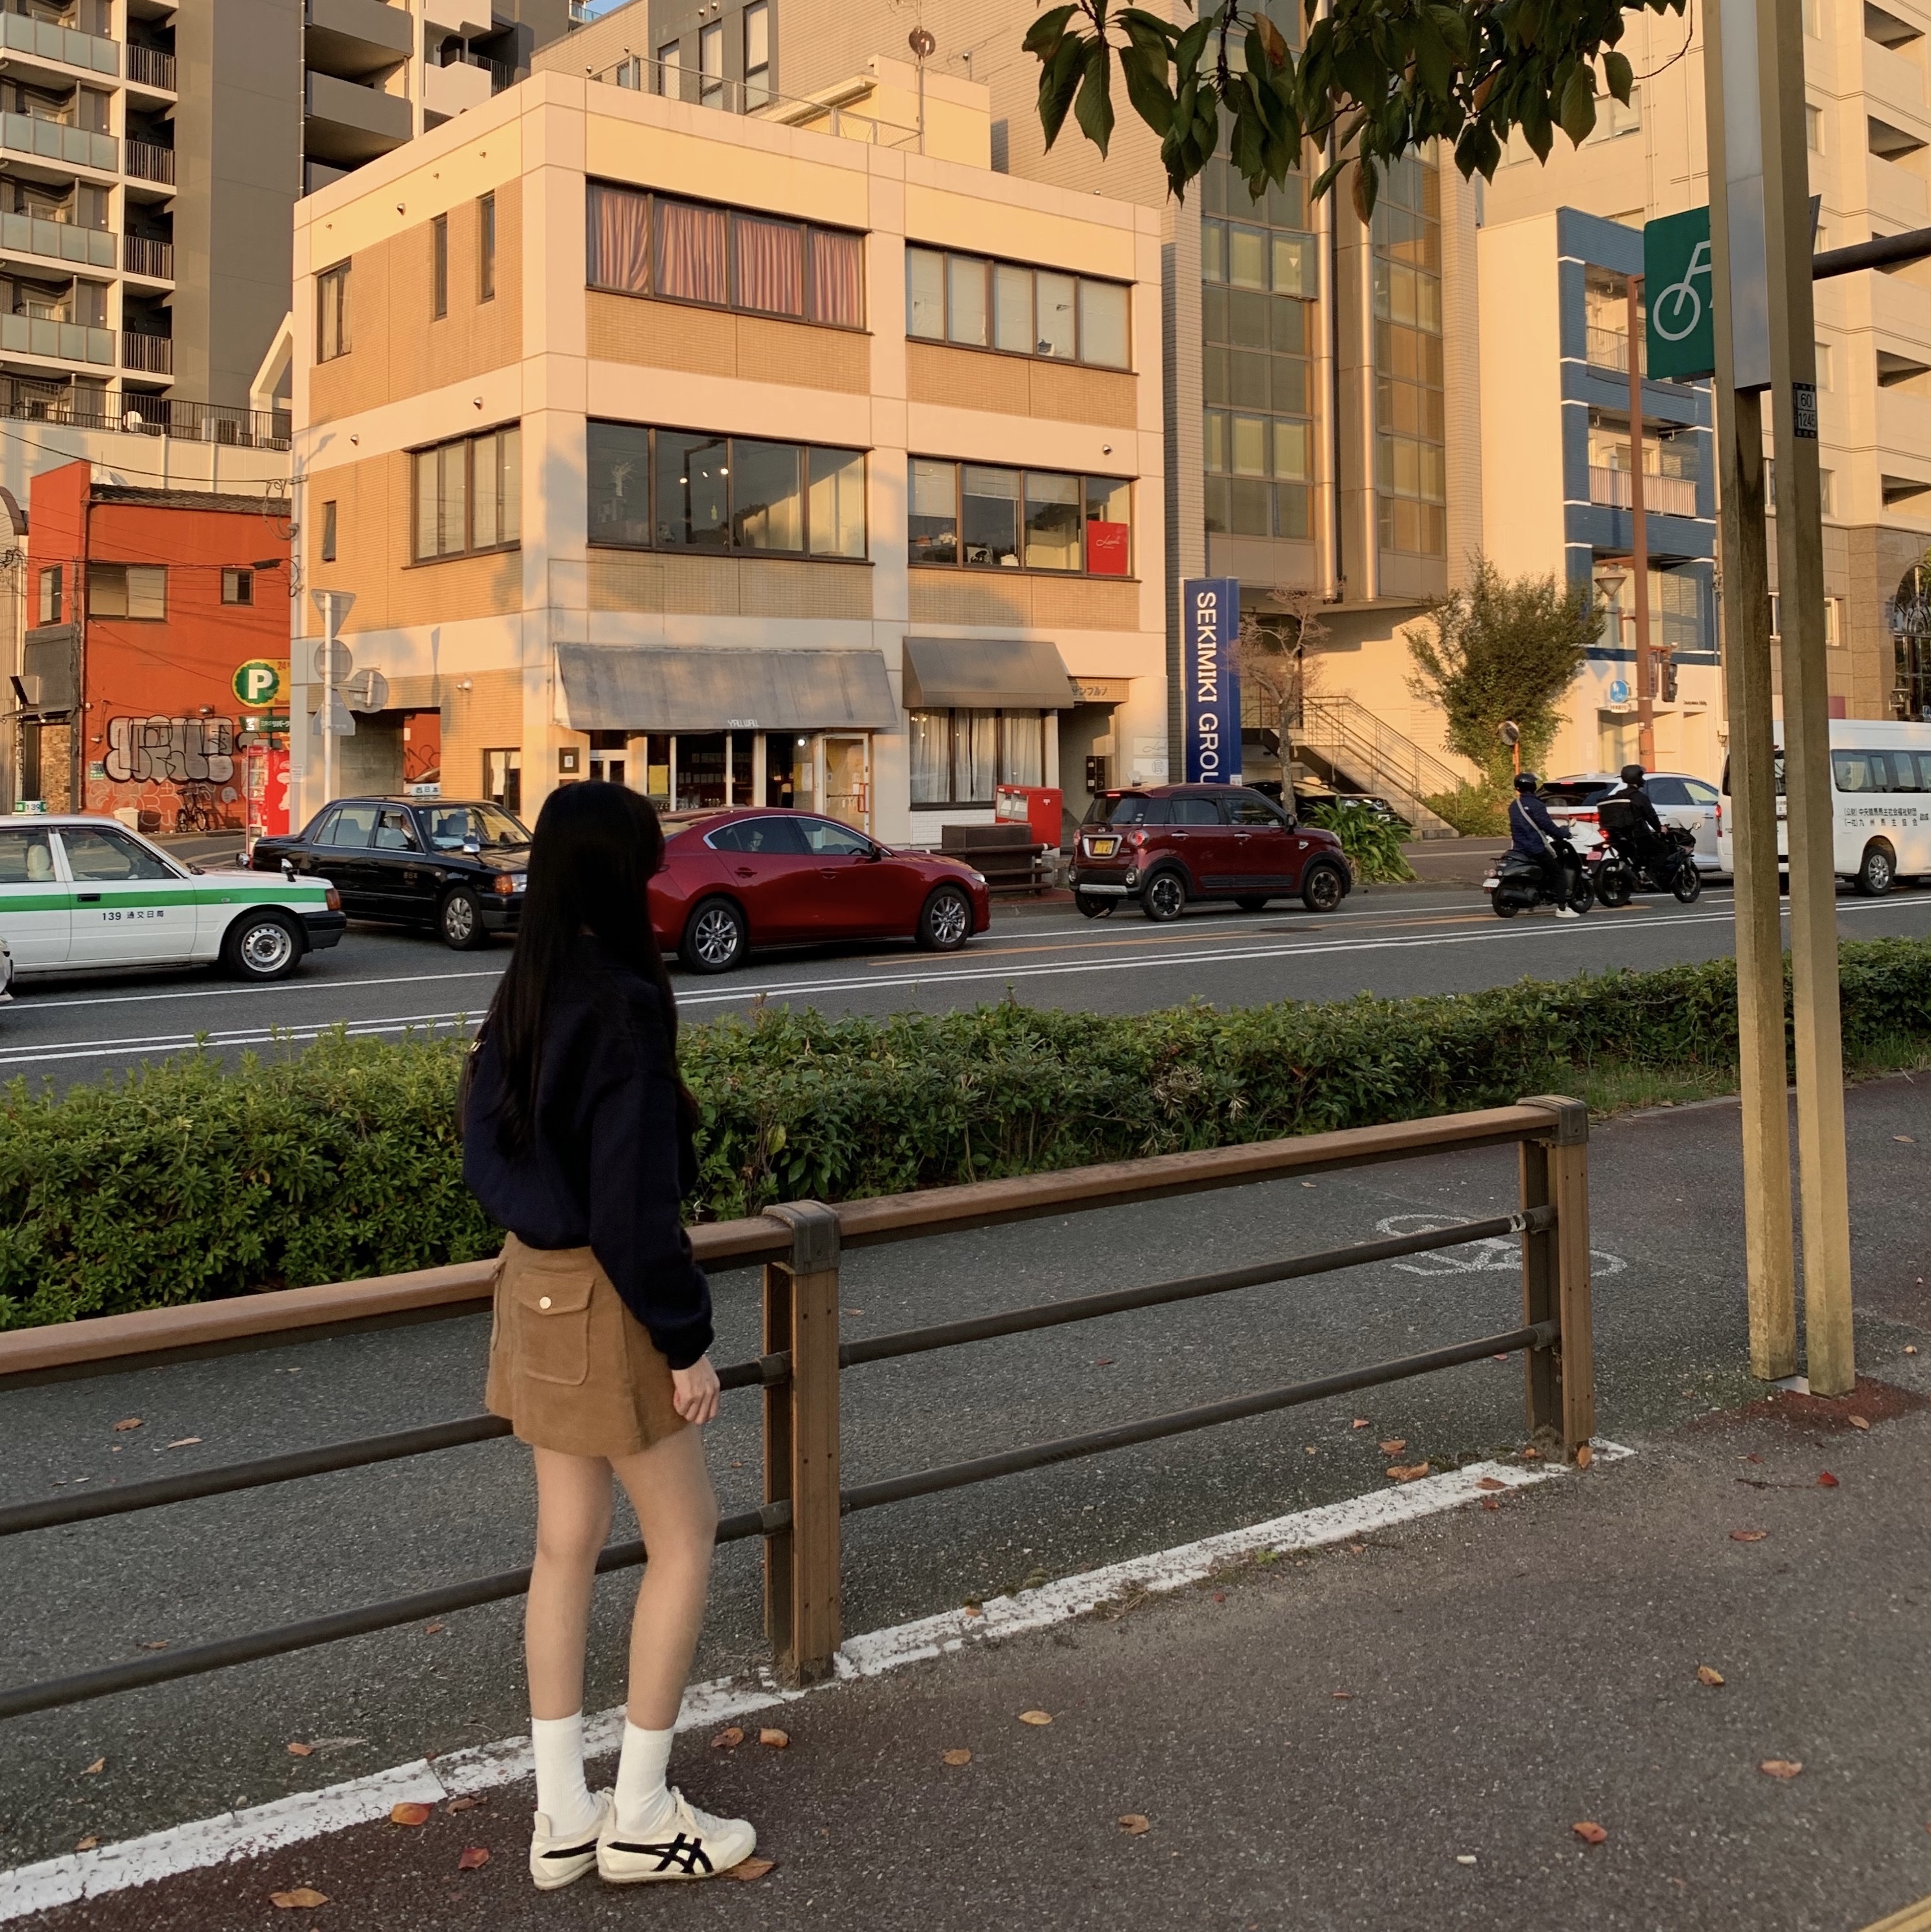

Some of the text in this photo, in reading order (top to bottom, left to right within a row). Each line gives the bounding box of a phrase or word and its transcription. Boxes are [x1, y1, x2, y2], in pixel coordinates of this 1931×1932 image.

[1800, 393, 1812, 408] 60
[1197, 591, 1217, 703] SEKIMIKI
[248, 668, 273, 699] P
[102, 912, 122, 921] 139
